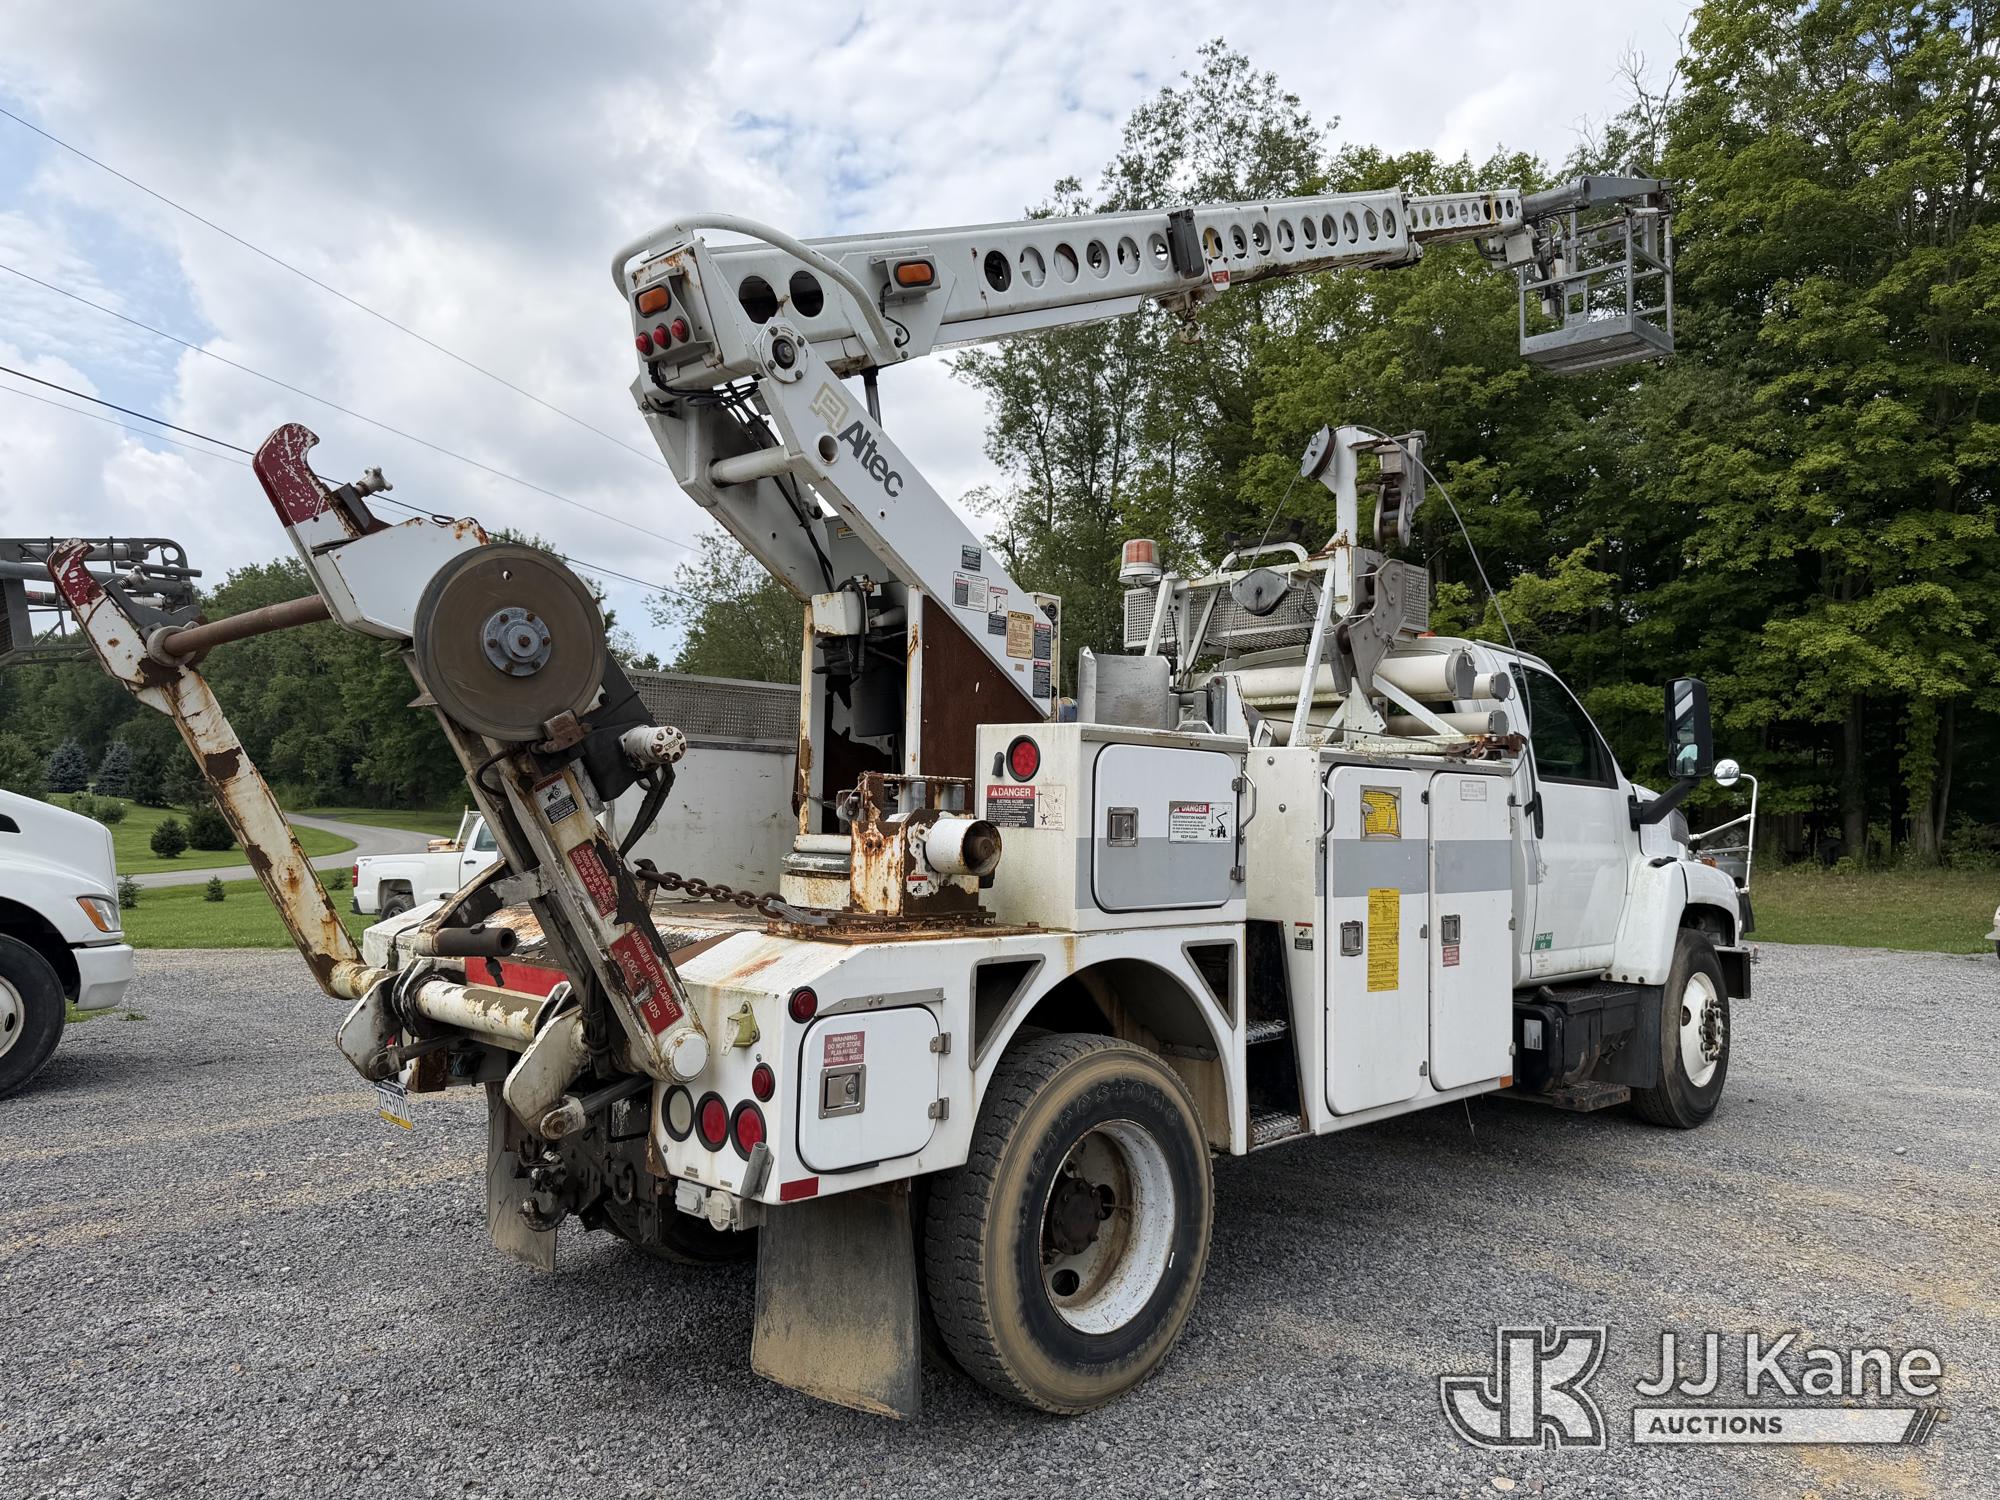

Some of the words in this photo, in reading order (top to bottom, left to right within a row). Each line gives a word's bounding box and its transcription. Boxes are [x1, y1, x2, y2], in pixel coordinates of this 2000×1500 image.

[837, 420, 904, 498] Altec
[998, 787, 1031, 797] DANGER
[1181, 803, 1207, 813] DANGER
[571, 850, 582, 864] 1000
[578, 863, 588, 876] LBS
[585, 875, 592, 883] AT
[578, 849, 591, 867] 20000
[587, 867, 601, 886] IN-LBS
[586, 849, 603, 874] MAXIMUM
[598, 873, 609, 887] LINE
[631, 931, 651, 963] MAXIMUM
[646, 961, 663, 988] LIFTING
[658, 986, 679, 1018] CAPACITY
[636, 978, 661, 1018] PNDS
[832, 1035, 858, 1043] WARNING
